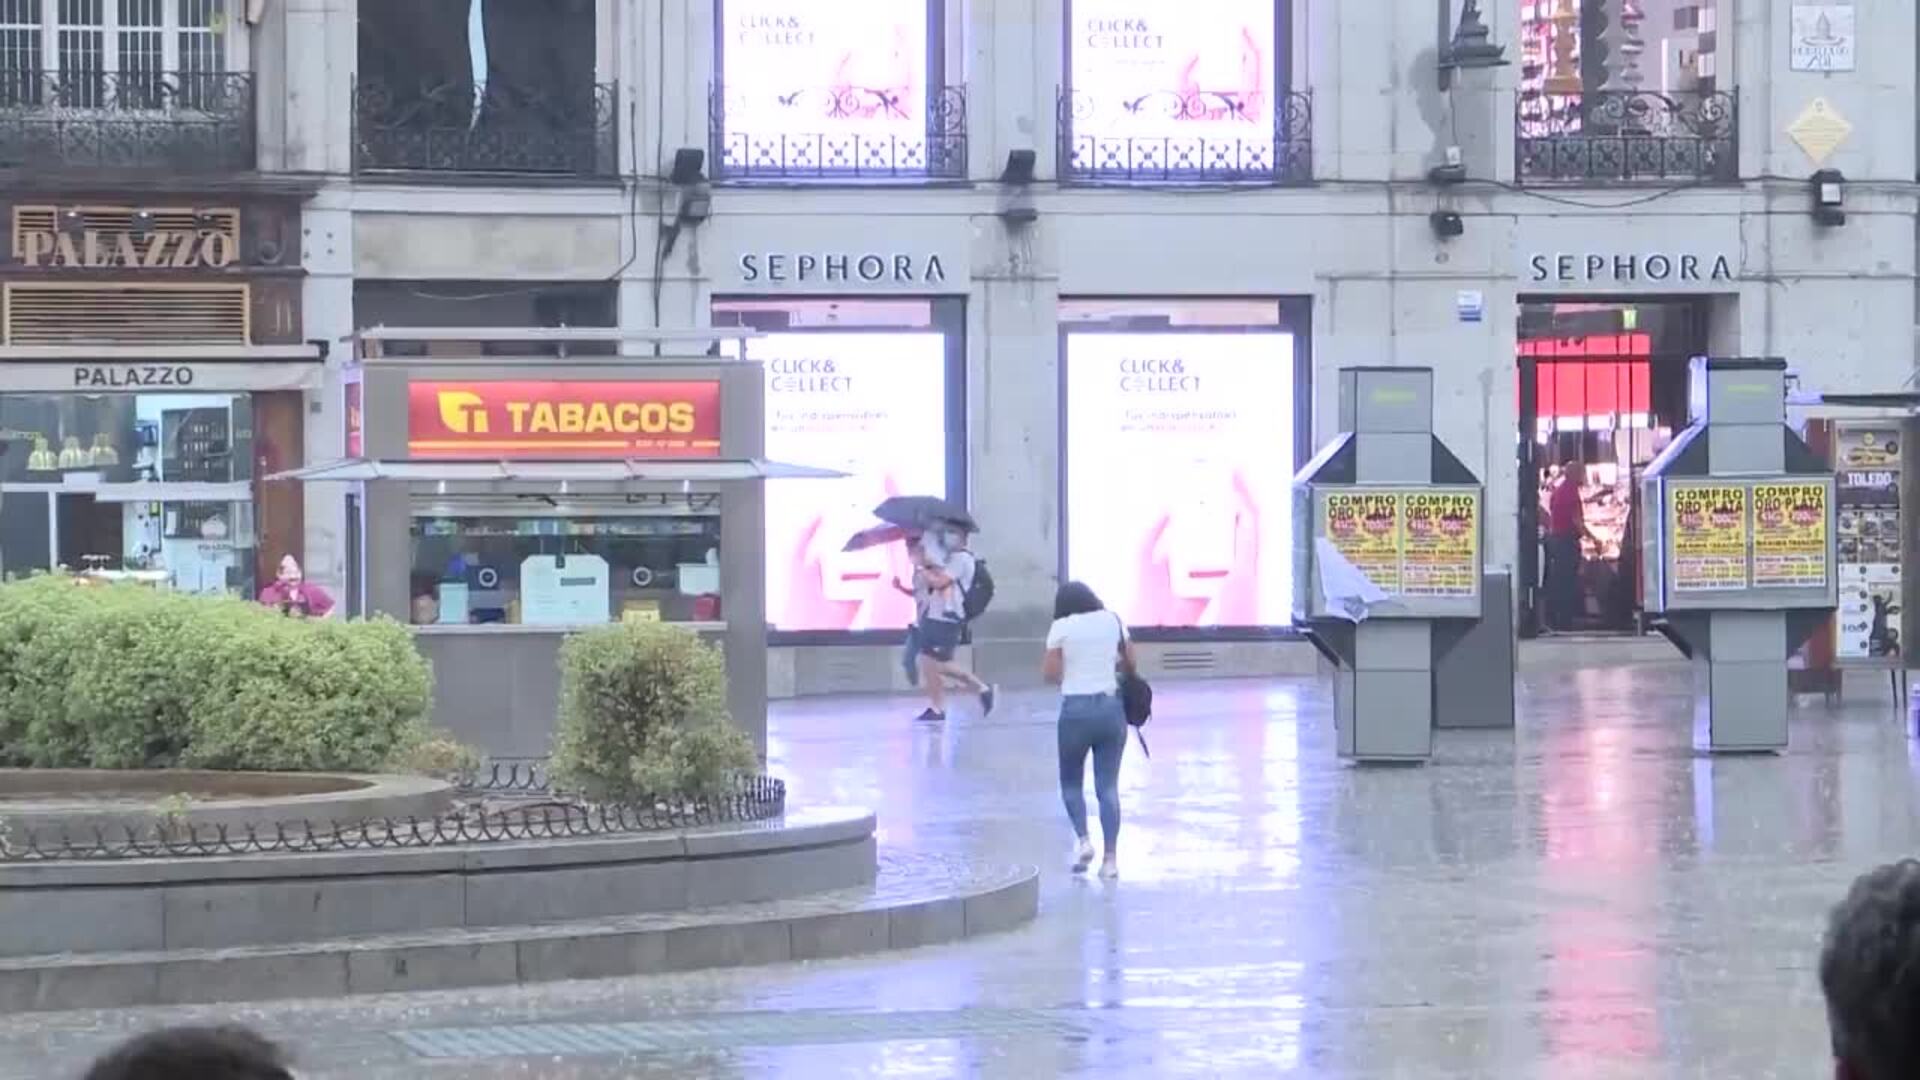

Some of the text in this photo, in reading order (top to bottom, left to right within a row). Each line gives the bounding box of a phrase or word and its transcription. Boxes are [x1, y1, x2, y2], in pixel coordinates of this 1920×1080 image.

[739, 31, 815, 45] CLLECT
[24, 230, 233, 268] PALAZZO
[742, 254, 946, 282] SEPHORA
[1532, 254, 1732, 282] SEPHORA
[771, 358, 836, 374] CLICK&
[1120, 358, 1185, 374] CLICK&
[75, 366, 193, 387] PALAZZO
[506, 401, 696, 434] TABACOS
[1848, 472, 1892, 487] TOLEDO
[1676, 489, 1743, 501] COMPRO
[1755, 486, 1823, 498] COMPRO
[1328, 495, 1397, 507] COMPRO
[1406, 495, 1474, 506] COMPRO
